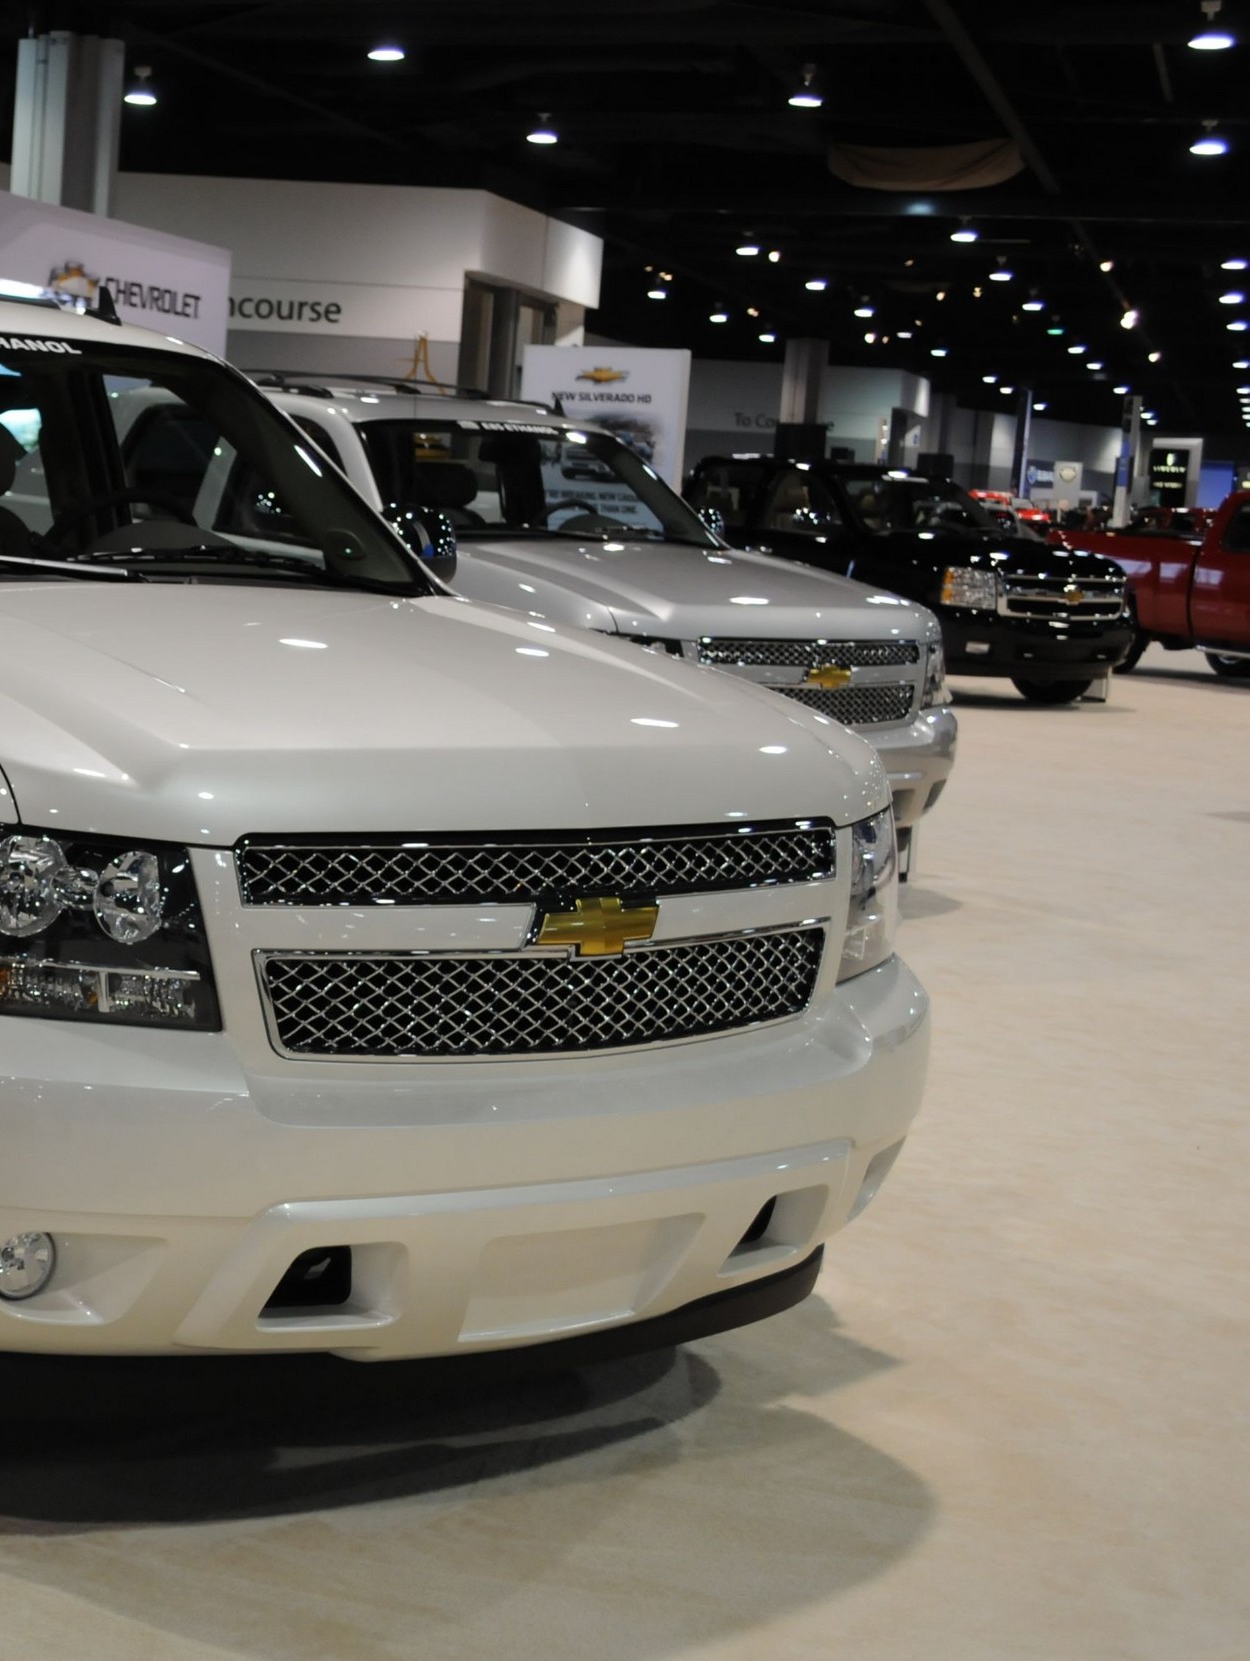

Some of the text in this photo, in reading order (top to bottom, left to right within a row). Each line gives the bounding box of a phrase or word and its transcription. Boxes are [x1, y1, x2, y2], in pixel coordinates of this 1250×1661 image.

[105, 277, 201, 319] CHEVROLET
[551, 391, 652, 404] NEW SILVERADO HD
